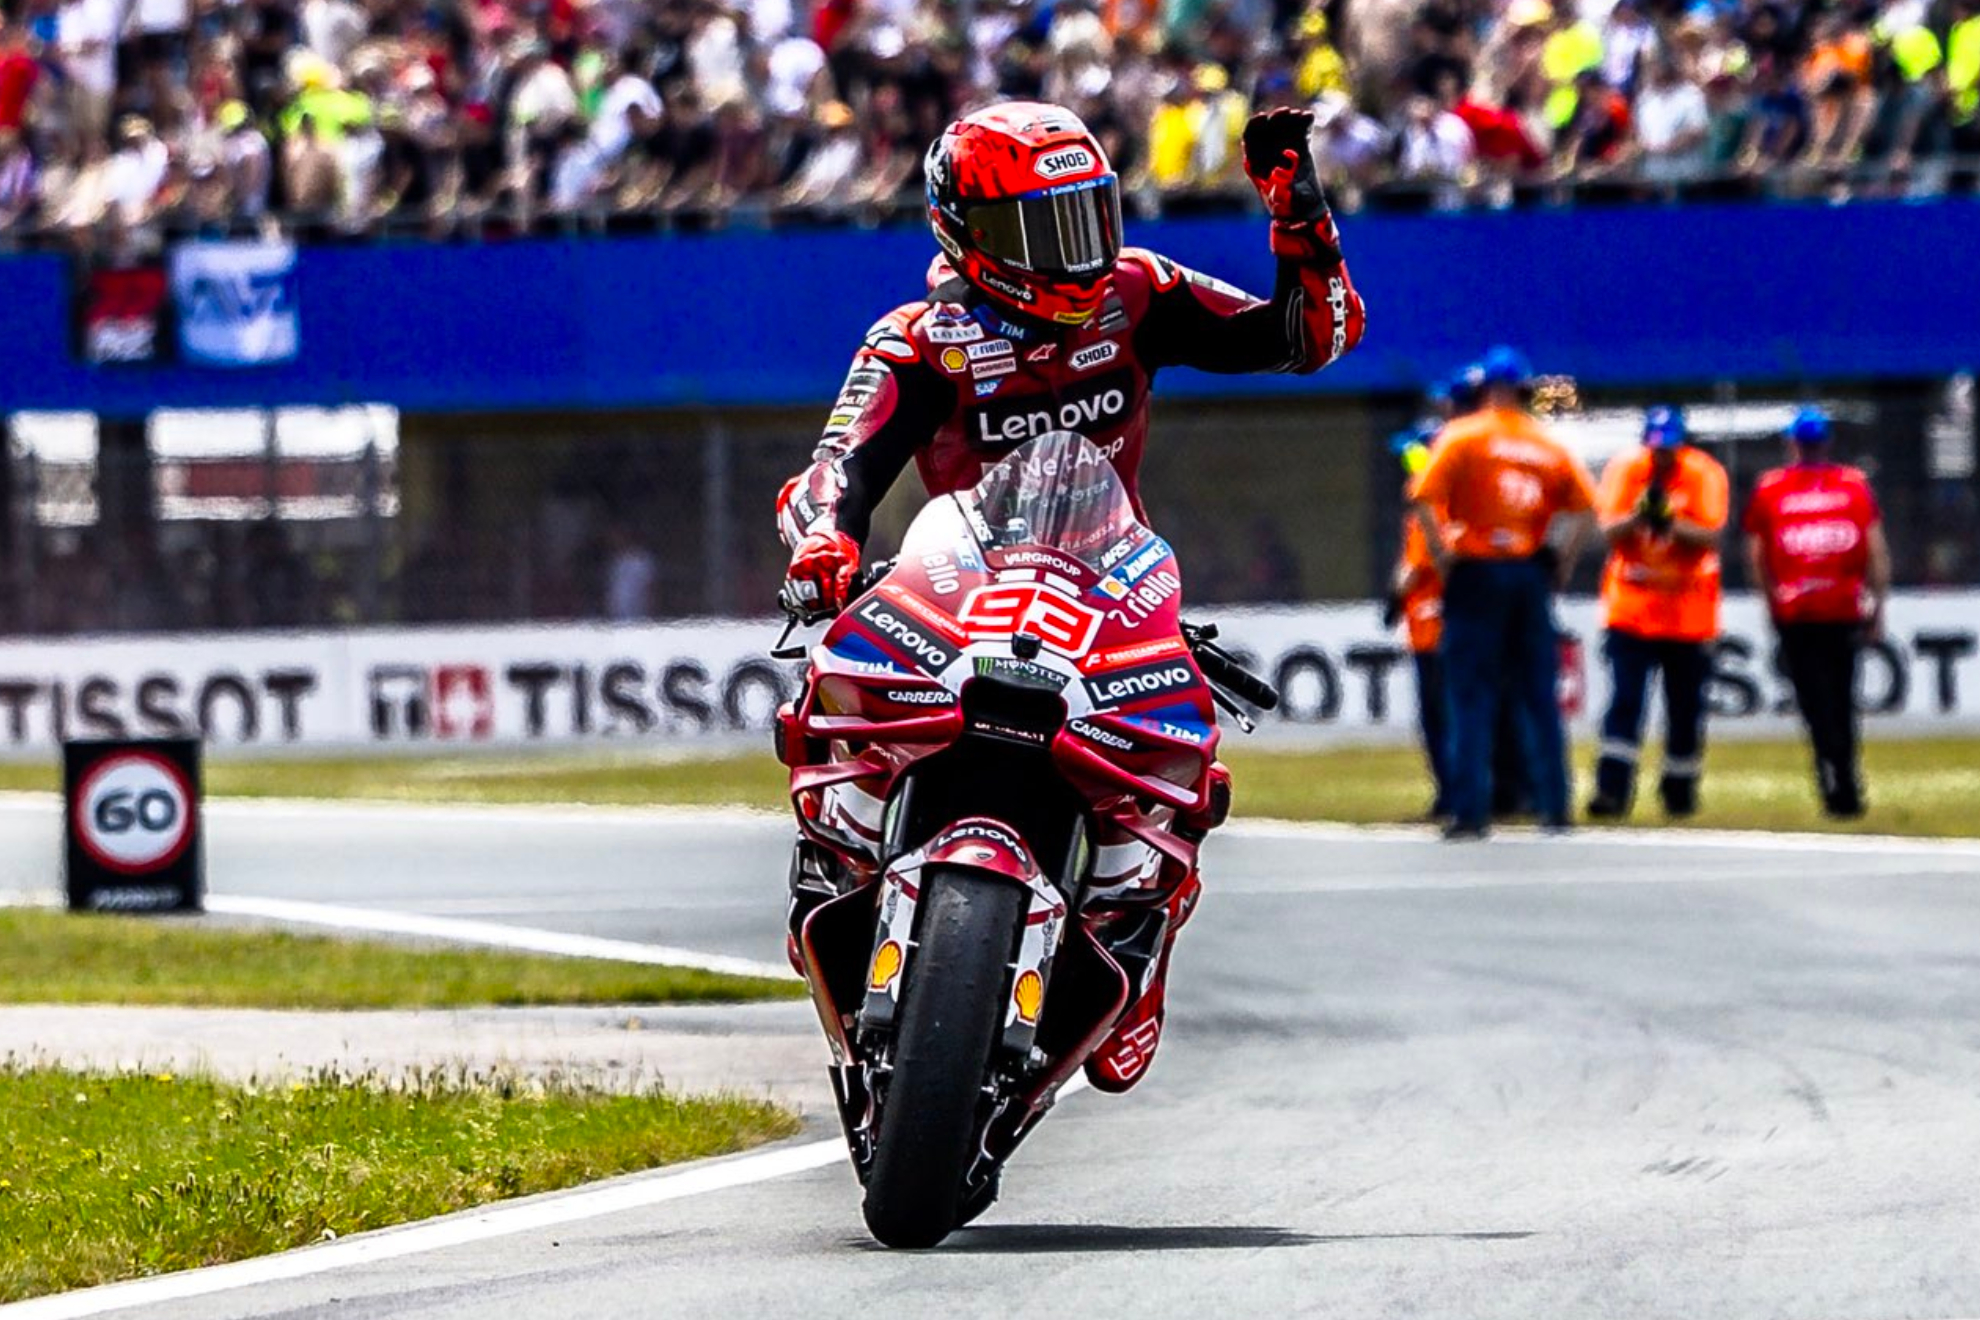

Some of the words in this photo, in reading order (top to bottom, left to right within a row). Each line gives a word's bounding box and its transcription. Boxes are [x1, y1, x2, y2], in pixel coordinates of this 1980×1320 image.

[1044, 151, 1089, 174] SHOEI
[982, 271, 1033, 301] Lenovo
[1000, 320, 1025, 339] TIM
[1075, 344, 1113, 366] SHOEI
[979, 388, 1125, 441] Lenovo
[860, 601, 947, 667] Lenovo
[961, 583, 1101, 657] 93
[857, 660, 894, 674] TIM
[507, 659, 793, 736] TISSO
[888, 690, 954, 704] CARRERA
[1090, 667, 1191, 702] Lenovo
[1069, 719, 1133, 751] CARRERA
[1163, 722, 1202, 744] TIM
[95, 787, 177, 833] 60
[938, 826, 1028, 863] Lenovo
